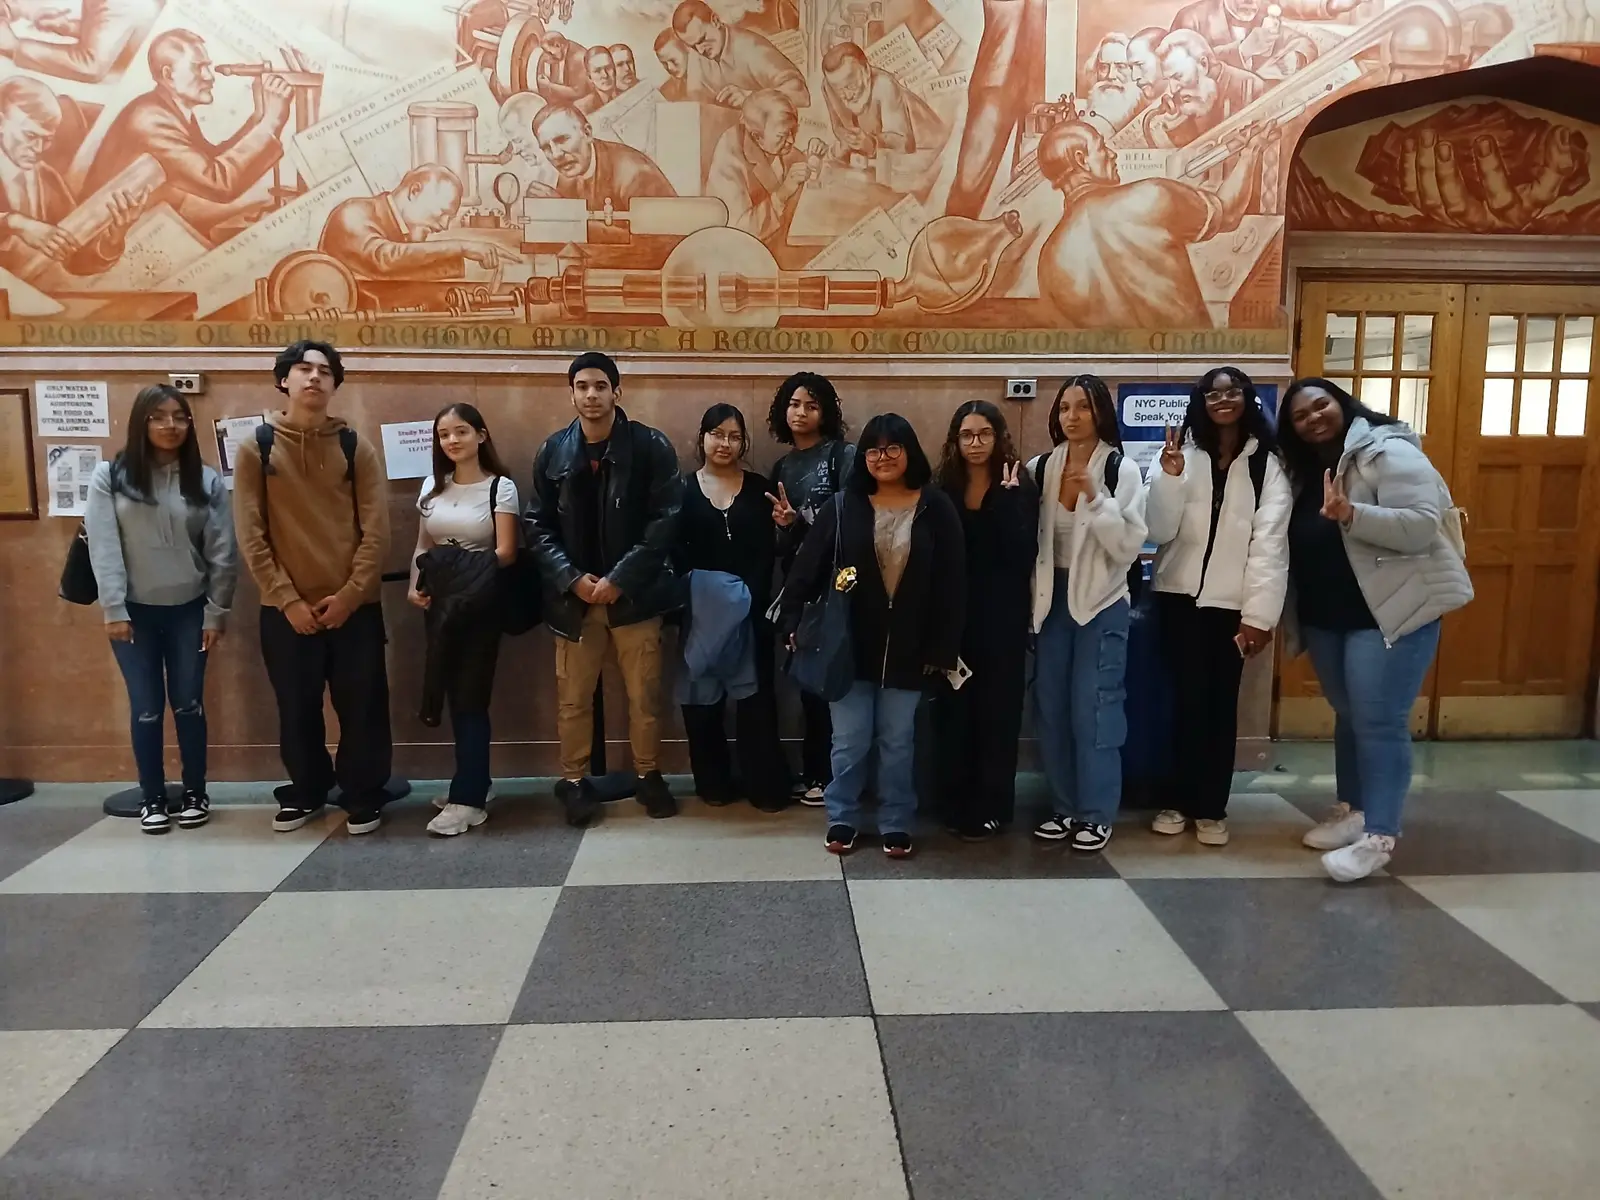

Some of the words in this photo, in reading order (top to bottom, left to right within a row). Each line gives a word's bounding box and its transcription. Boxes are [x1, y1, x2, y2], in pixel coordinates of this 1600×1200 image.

[436, 78, 478, 102] ERIMENT
[930, 75, 967, 91] PUPIN
[306, 102, 377, 141] RUTHERFORD
[384, 66, 447, 102] EXPERIMENT
[19, 324, 178, 344] PROGRESS
[677, 329, 698, 351] A
[712, 330, 834, 352] RECORD
[1135, 400, 1156, 408] NYC
[1159, 400, 1188, 408] Public
[1135, 412, 1164, 422] Speak
